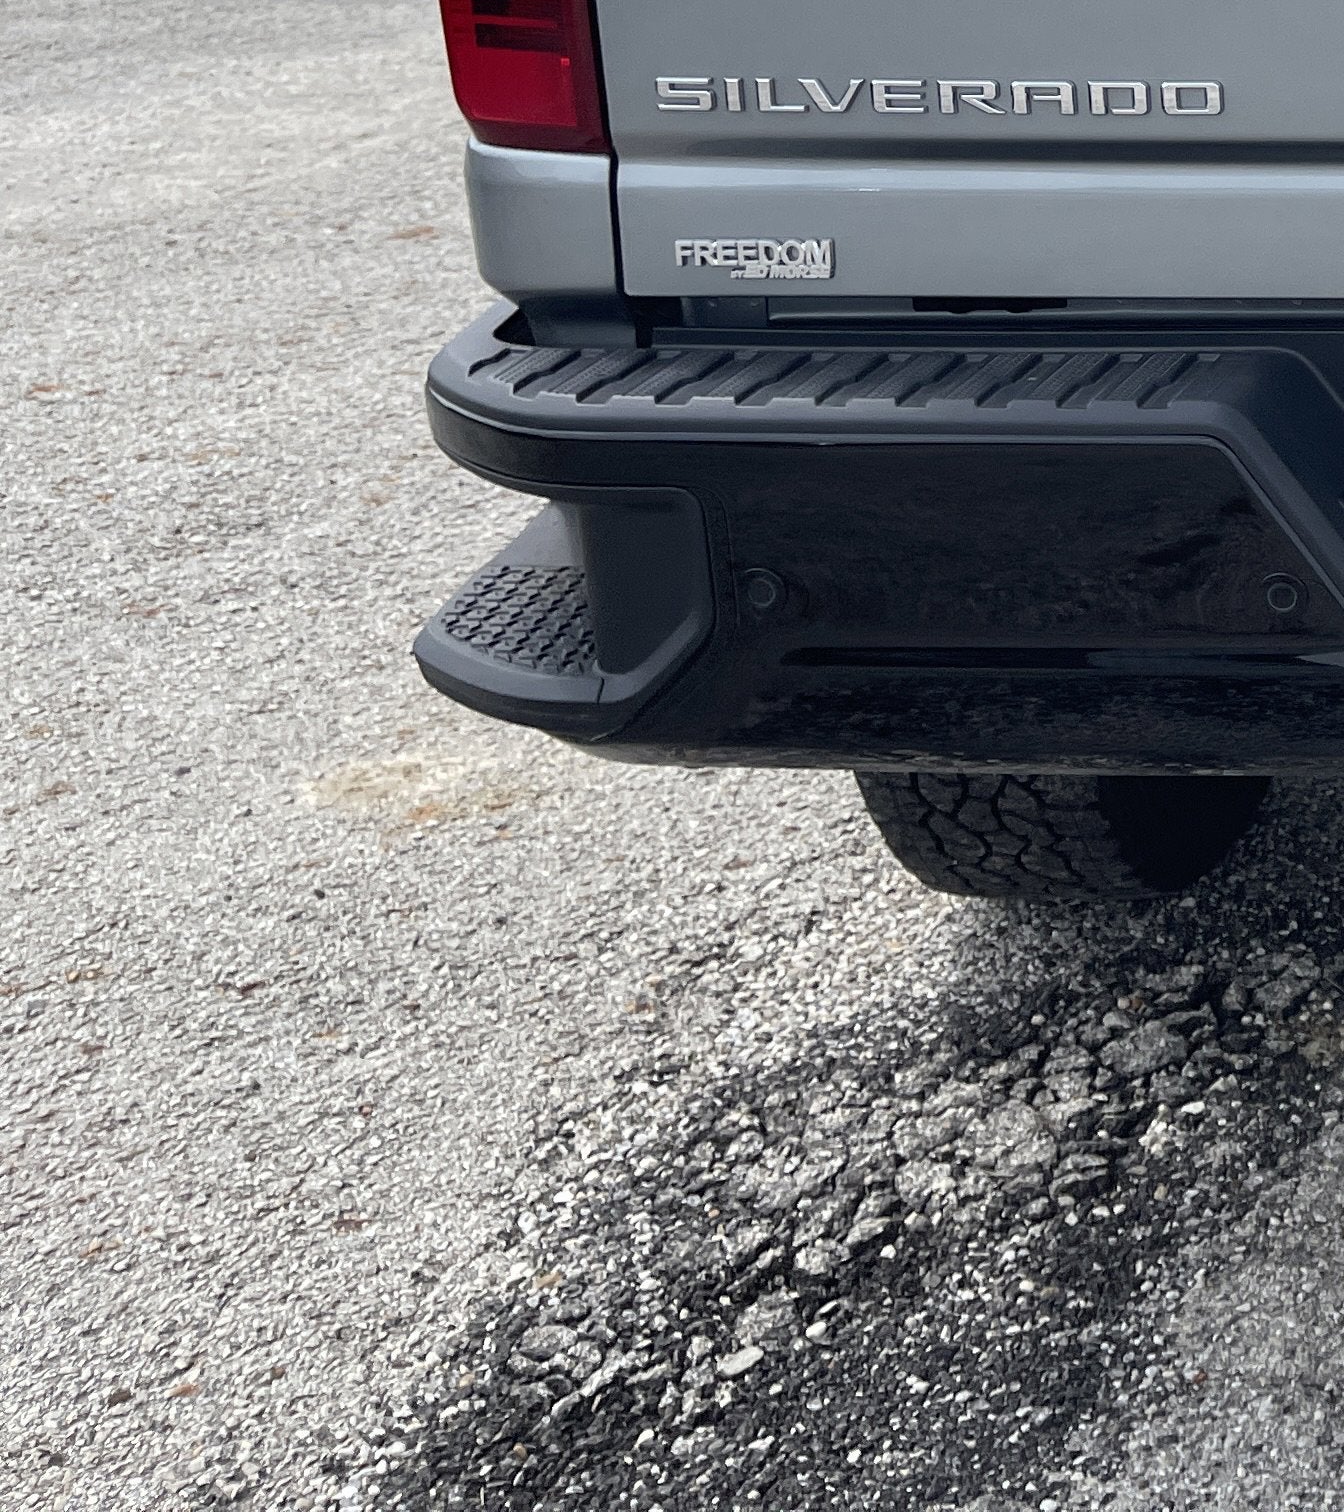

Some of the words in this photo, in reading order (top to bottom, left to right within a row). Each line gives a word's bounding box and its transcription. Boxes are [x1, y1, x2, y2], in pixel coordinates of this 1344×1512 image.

[655, 76, 1225, 117] SILVERADO
[674, 238, 834, 267] FREEDOM
[769, 265, 832, 279] MORSE
